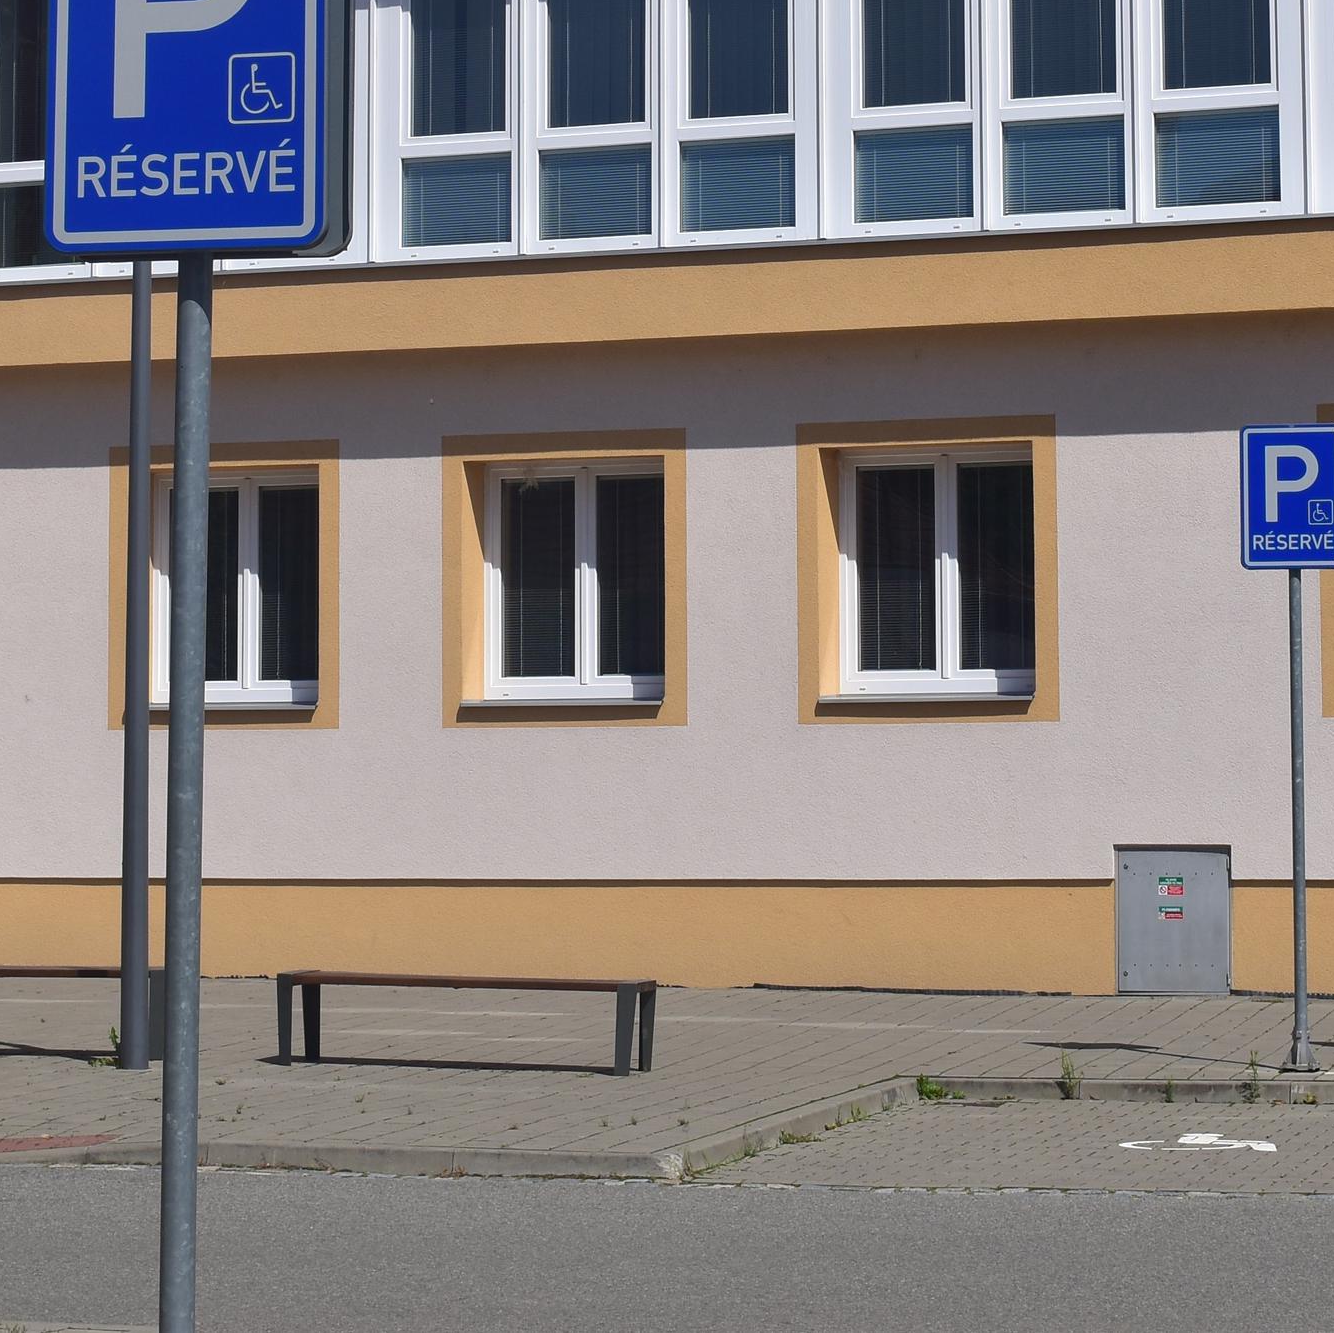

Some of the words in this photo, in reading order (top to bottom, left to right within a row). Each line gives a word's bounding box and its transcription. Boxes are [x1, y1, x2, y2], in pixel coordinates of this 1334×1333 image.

[76, 138, 297, 199] RÉSERVÉ
[1264, 445, 1319, 522] P
[1252, 530, 1334, 551] RÉSERVÉ
